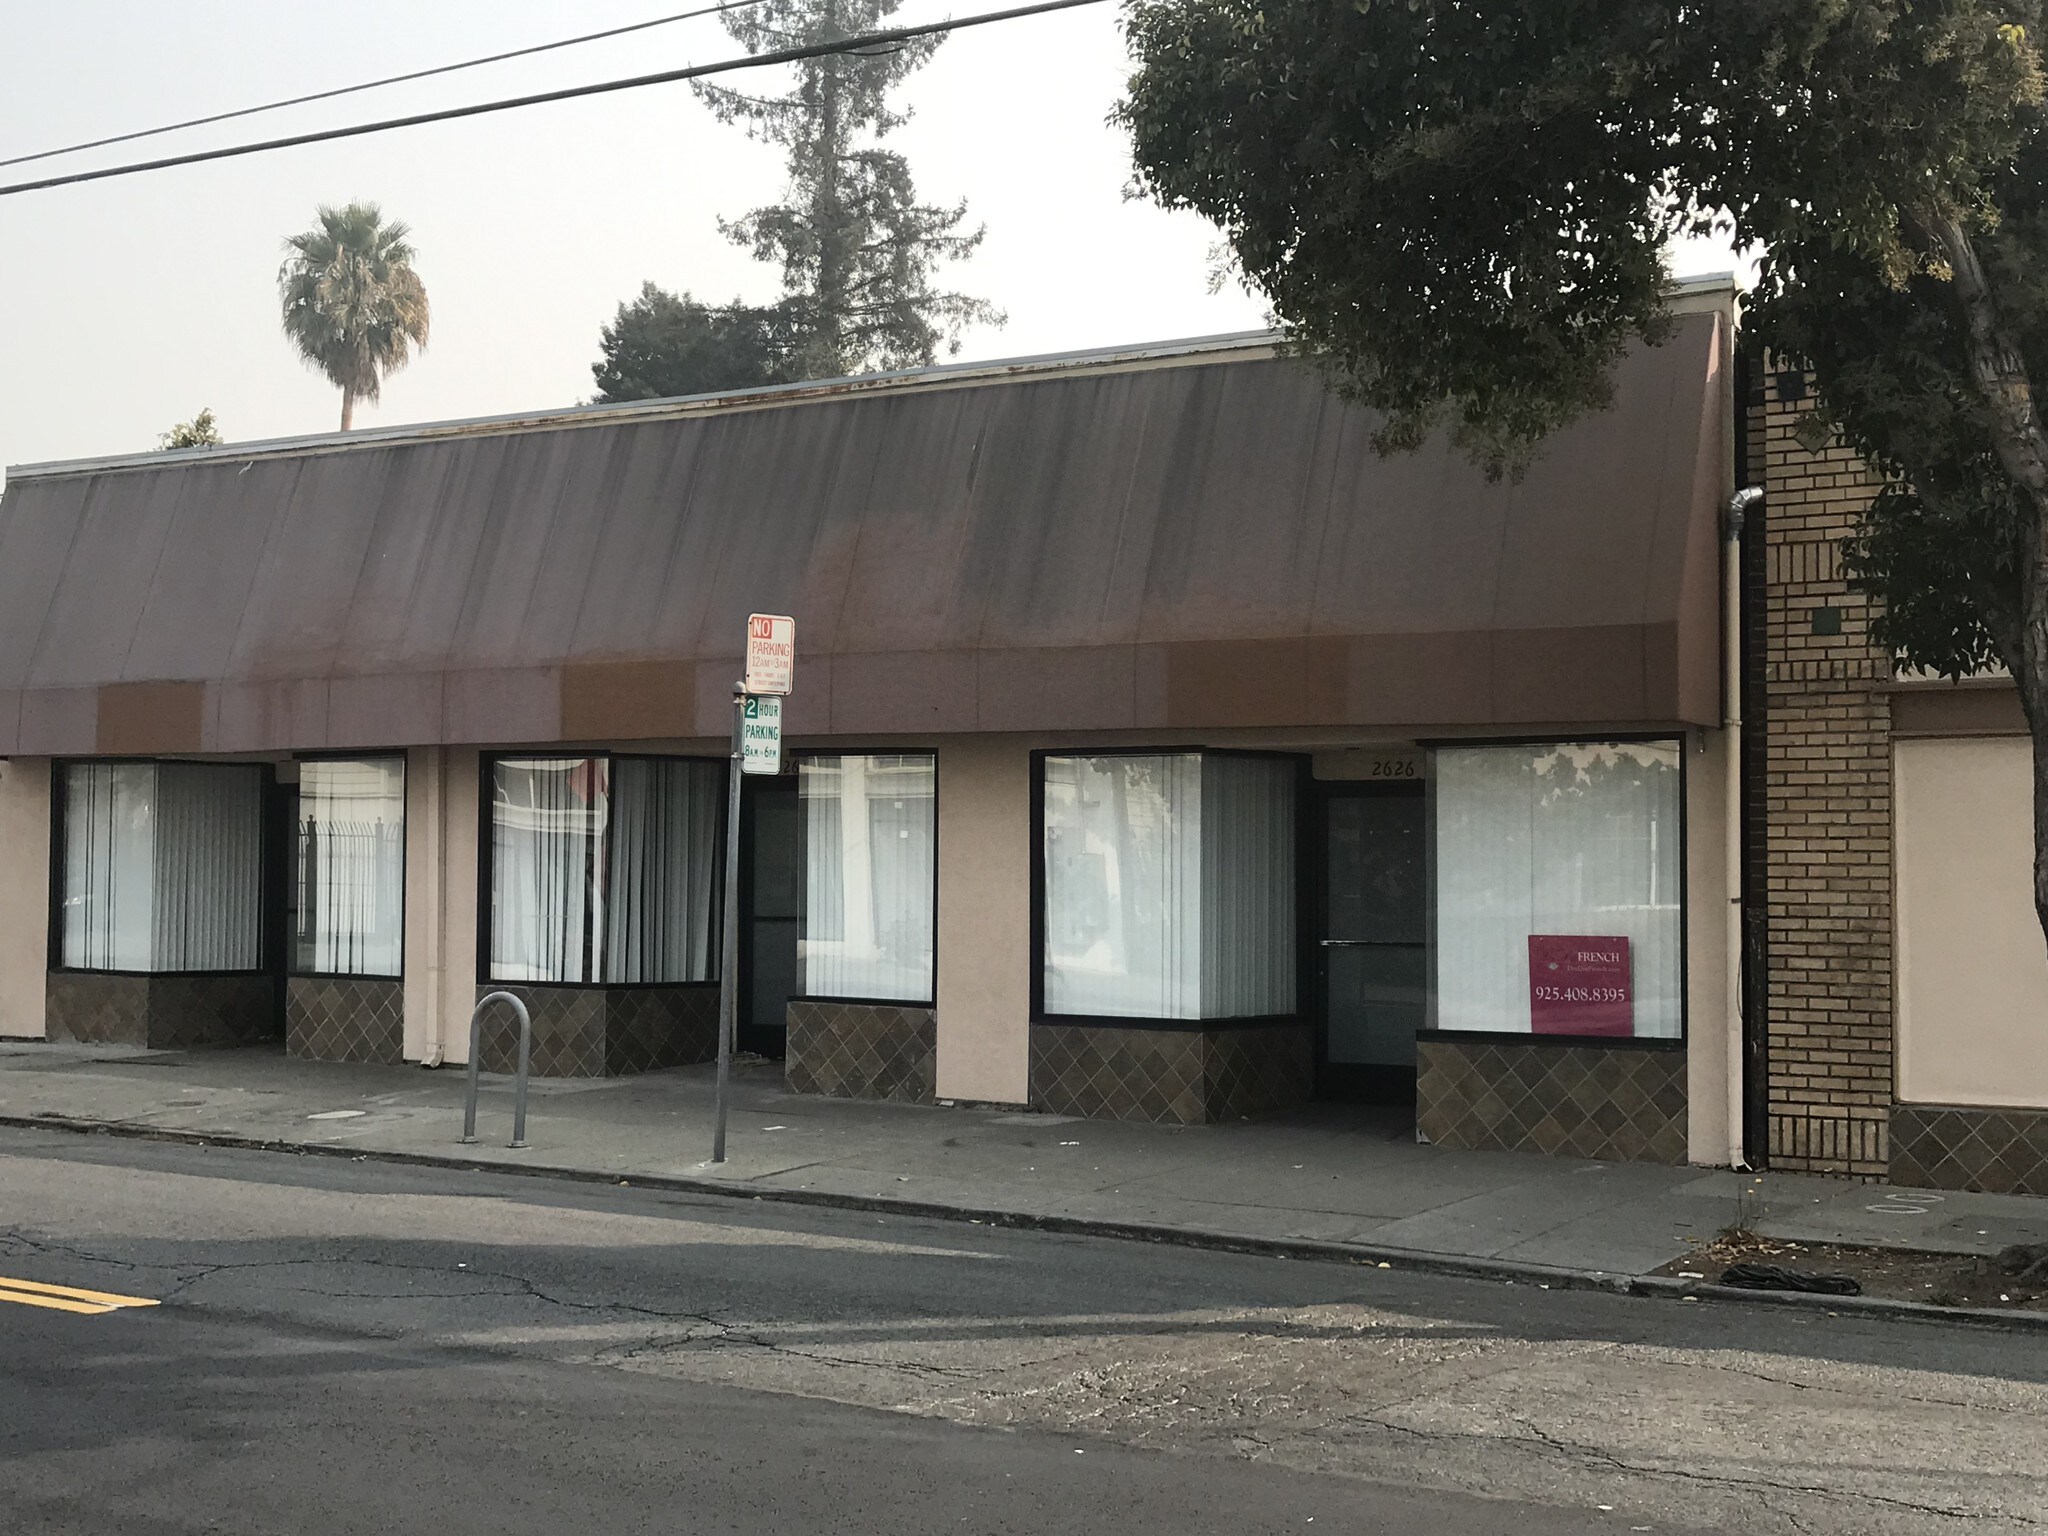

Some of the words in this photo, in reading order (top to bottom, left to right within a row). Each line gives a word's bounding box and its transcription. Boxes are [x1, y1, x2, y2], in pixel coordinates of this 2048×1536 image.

[753, 618, 770, 637] NO
[752, 641, 790, 657] PARKING
[746, 699, 756, 715] 2
[758, 704, 778, 717] HOUR
[745, 724, 778, 740] PARKING
[1372, 760, 1414, 777] 2626
[1577, 952, 1620, 962] FRENCH
[1535, 986, 1625, 1002] 925.408.8395
